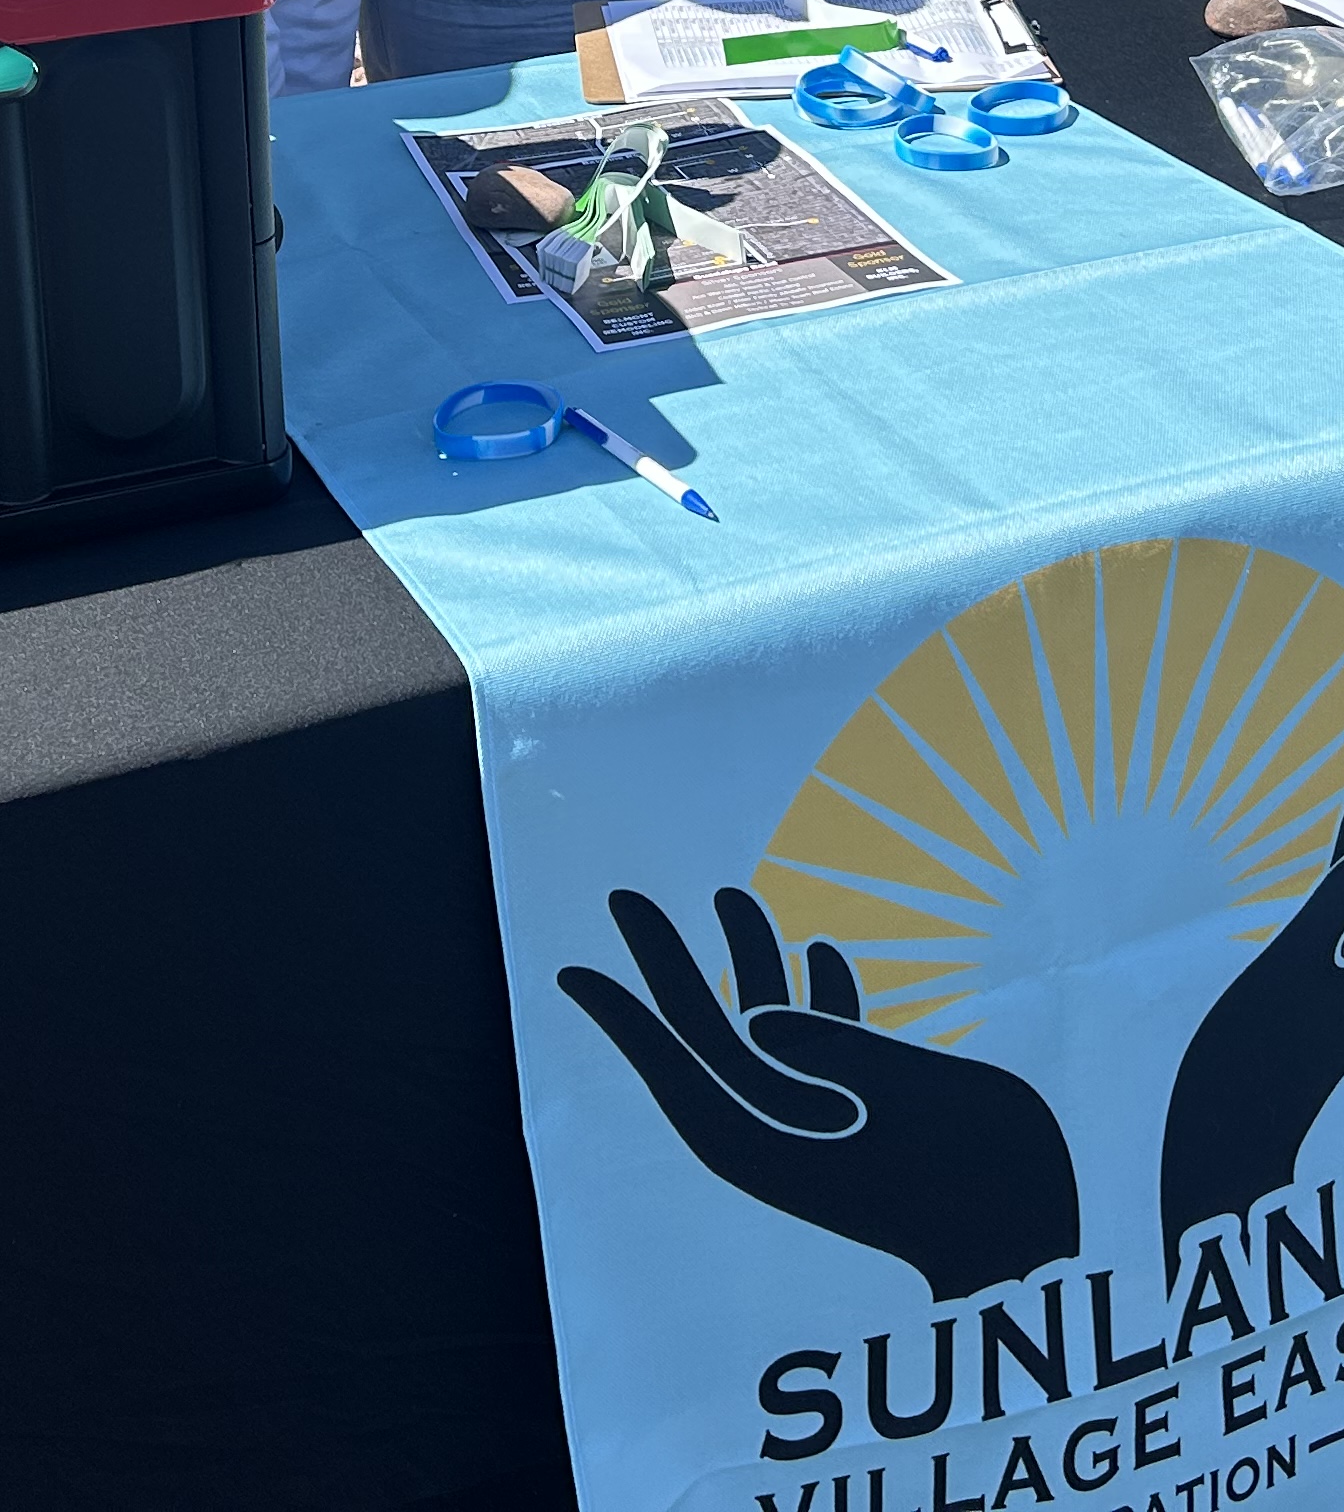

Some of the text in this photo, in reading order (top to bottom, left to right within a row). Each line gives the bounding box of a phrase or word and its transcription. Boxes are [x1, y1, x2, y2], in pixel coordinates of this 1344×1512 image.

[853, 249, 887, 260] Gold
[847, 255, 905, 268] Sponsor
[597, 297, 633, 307] Gold
[590, 302, 650, 316] Sponsor
[602, 311, 654, 325] BELMONT
[611, 317, 656, 329] CUSTOM
[602, 319, 674, 336] REMODELING
